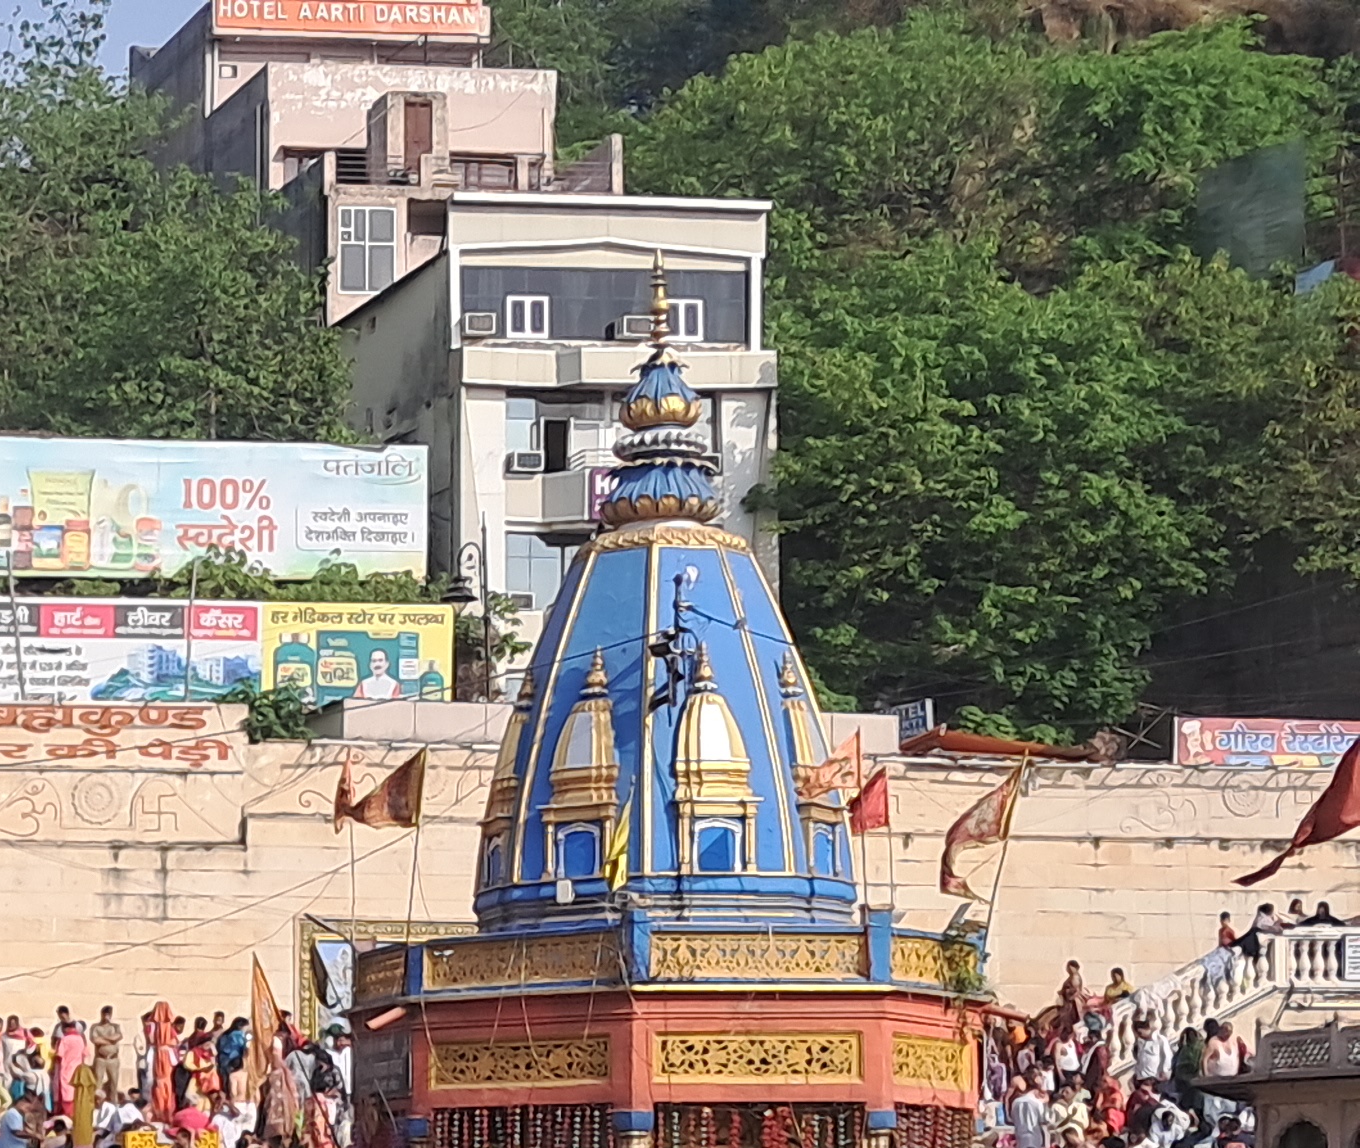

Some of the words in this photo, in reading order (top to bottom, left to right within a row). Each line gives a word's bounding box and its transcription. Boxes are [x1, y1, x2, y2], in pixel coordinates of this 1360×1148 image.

[218, 0, 288, 20] HOTEL
[298, 2, 365, 22] AARTI
[375, 5, 476, 25] DARSHAN
[183, 477, 271, 511] 100%
[175, 514, 278, 553] स्वदेशी
[127, 607, 172, 628] लीवर
[270, 610, 289, 625] हर
[1215, 721, 1278, 753] गौरव
